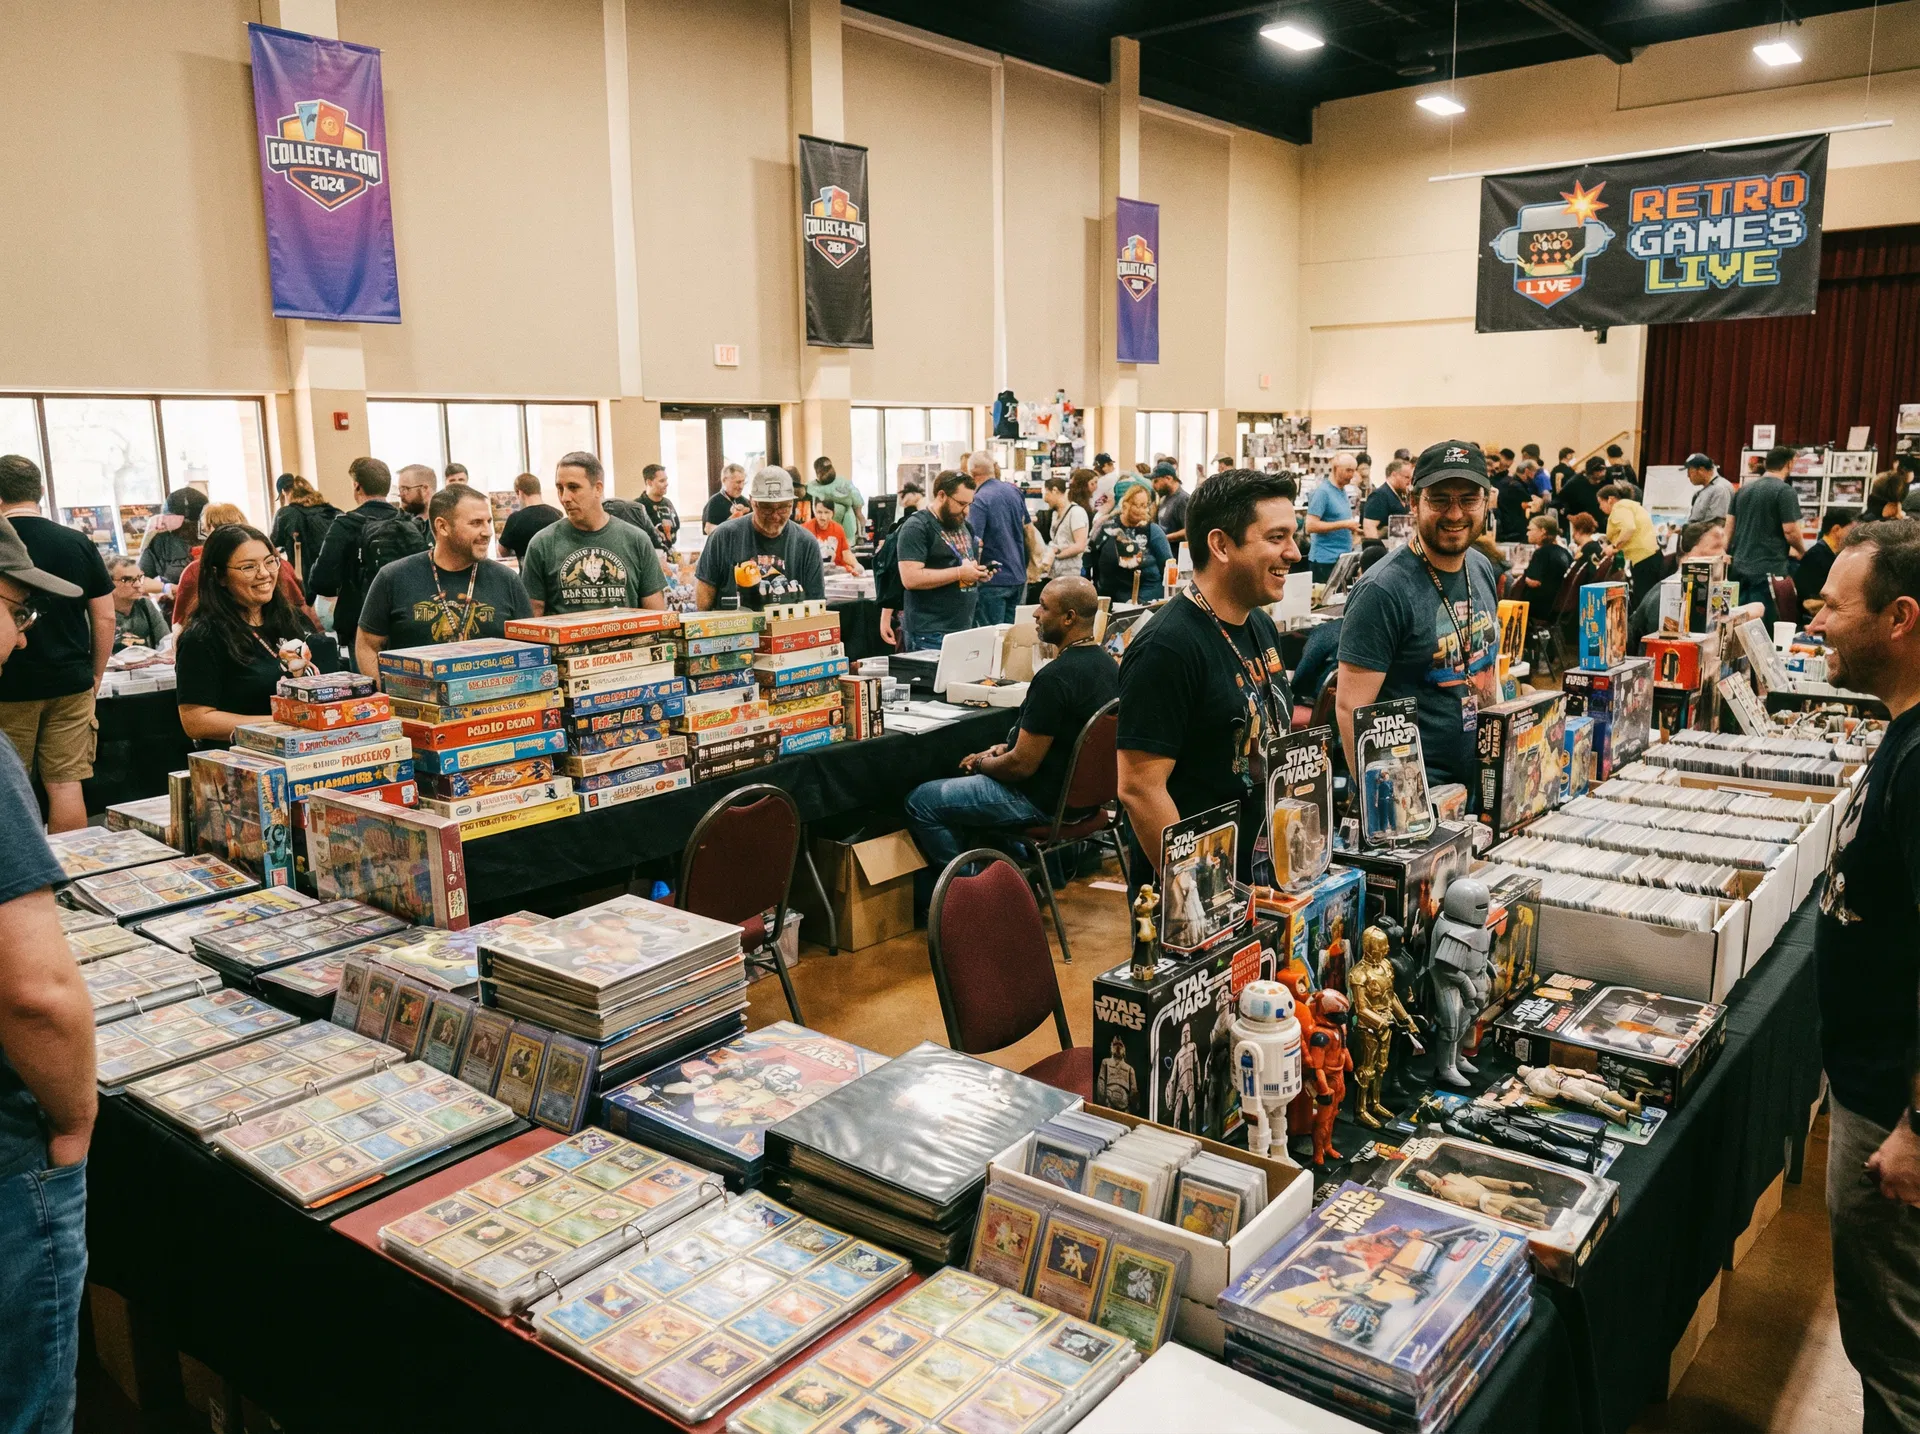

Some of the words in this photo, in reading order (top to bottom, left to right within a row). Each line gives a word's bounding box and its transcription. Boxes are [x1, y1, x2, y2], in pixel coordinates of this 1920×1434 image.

[270, 142, 377, 176] COLLECT-A-CON
[311, 175, 345, 192] 2024
[1631, 174, 1806, 222] RETRO
[1630, 211, 1803, 257] GAMES
[1648, 249, 1778, 291] LIVE
[1525, 278, 1572, 295] LIVE
[1371, 713, 1414, 734] STAR
[1366, 727, 1417, 749] WARS
[1282, 744, 1323, 770] STAR
[1277, 759, 1327, 786] WARS
[1168, 841, 1198, 862] WARS
[1169, 830, 1197, 849] STAR
[1172, 968, 1213, 1003] STAR
[1095, 995, 1146, 1018] STAR
[1095, 1005, 1146, 1031] WARS
[1166, 986, 1212, 1026] WARS
[1318, 1190, 1366, 1228] STAR
[1332, 1189, 1386, 1234] WARS
